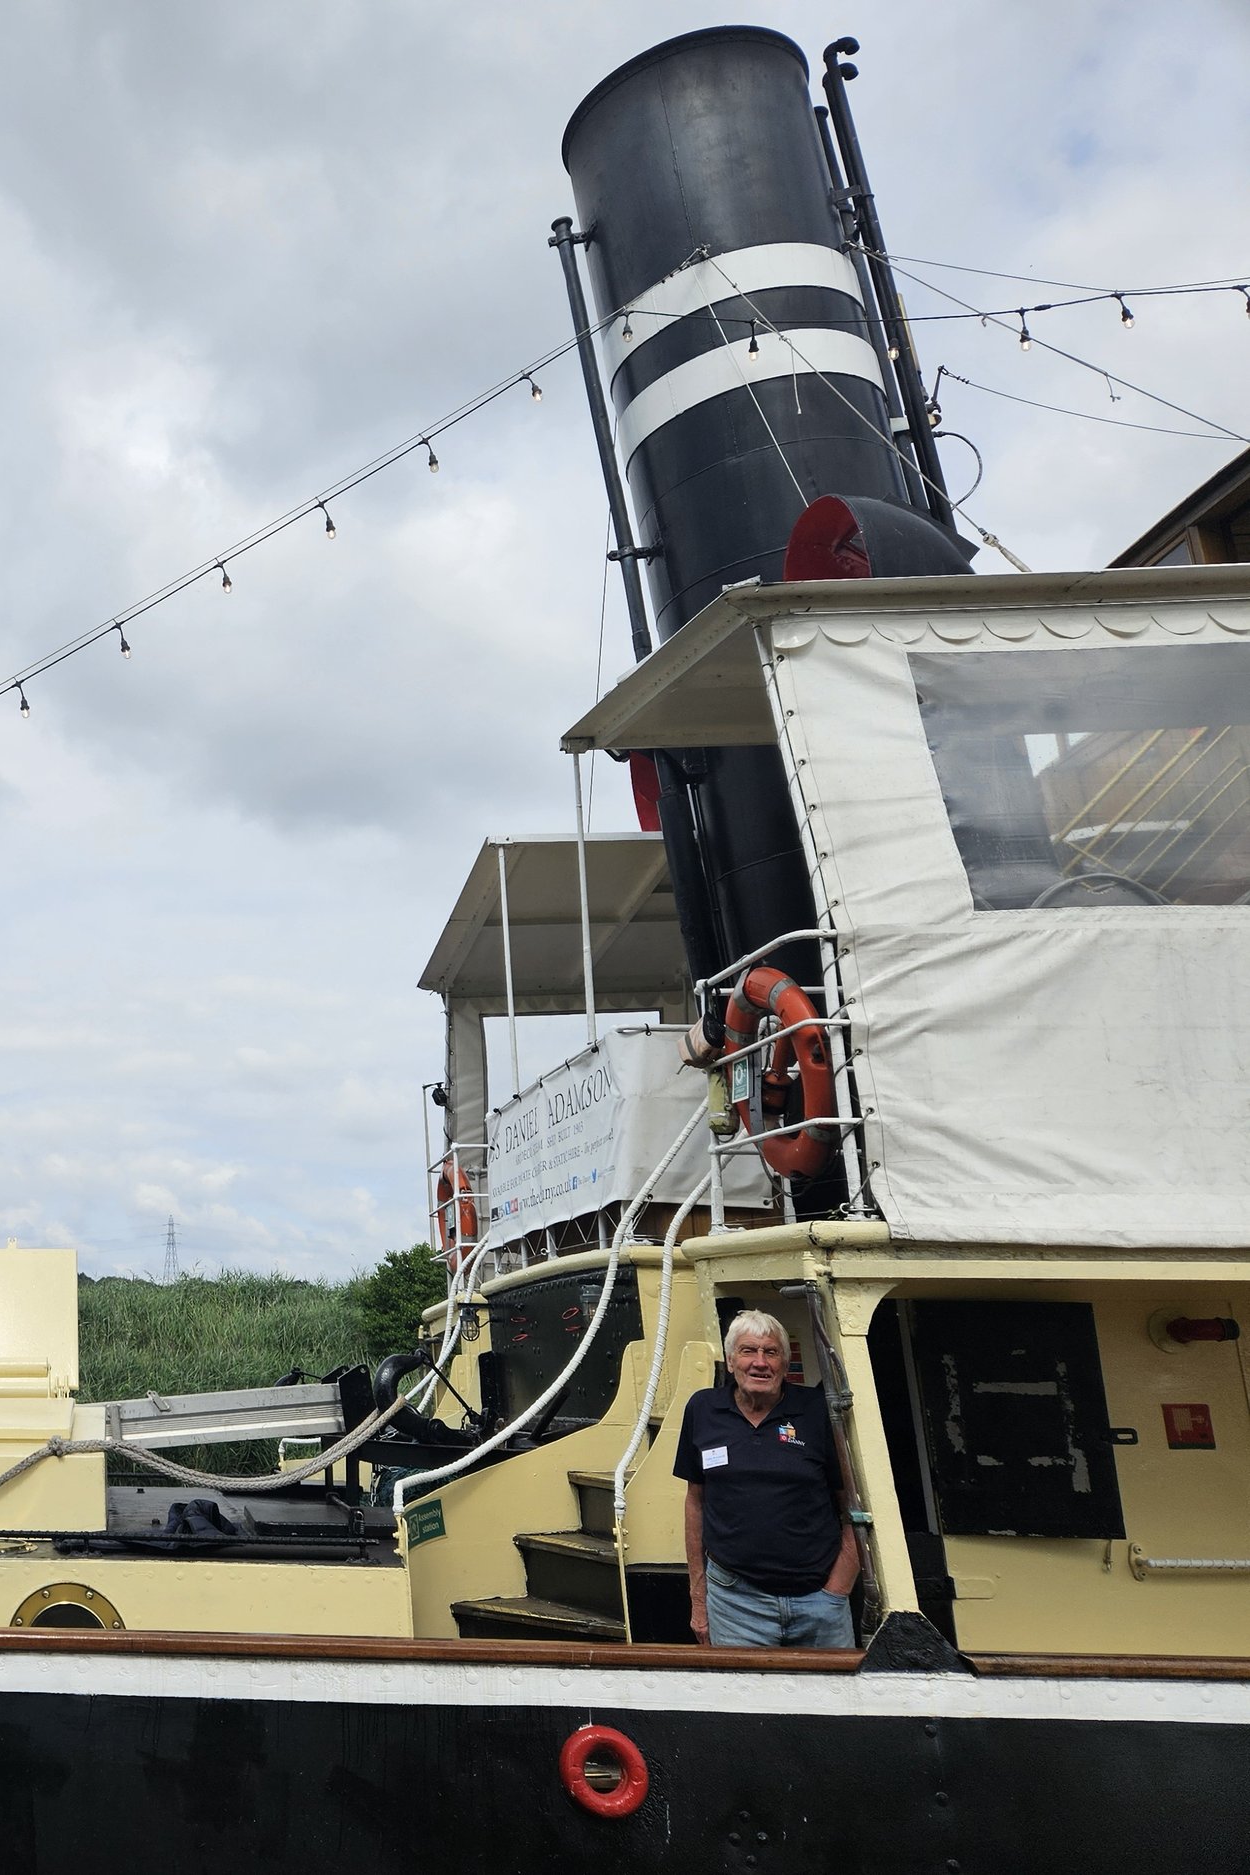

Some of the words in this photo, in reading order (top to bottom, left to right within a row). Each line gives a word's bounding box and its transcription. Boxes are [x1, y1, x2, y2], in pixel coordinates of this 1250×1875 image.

[505, 1107, 539, 1153] DANIEL
[548, 1060, 614, 1129] ADAMSON
[419, 1508, 441, 1521] Assembly
[422, 1522, 440, 1533] station
